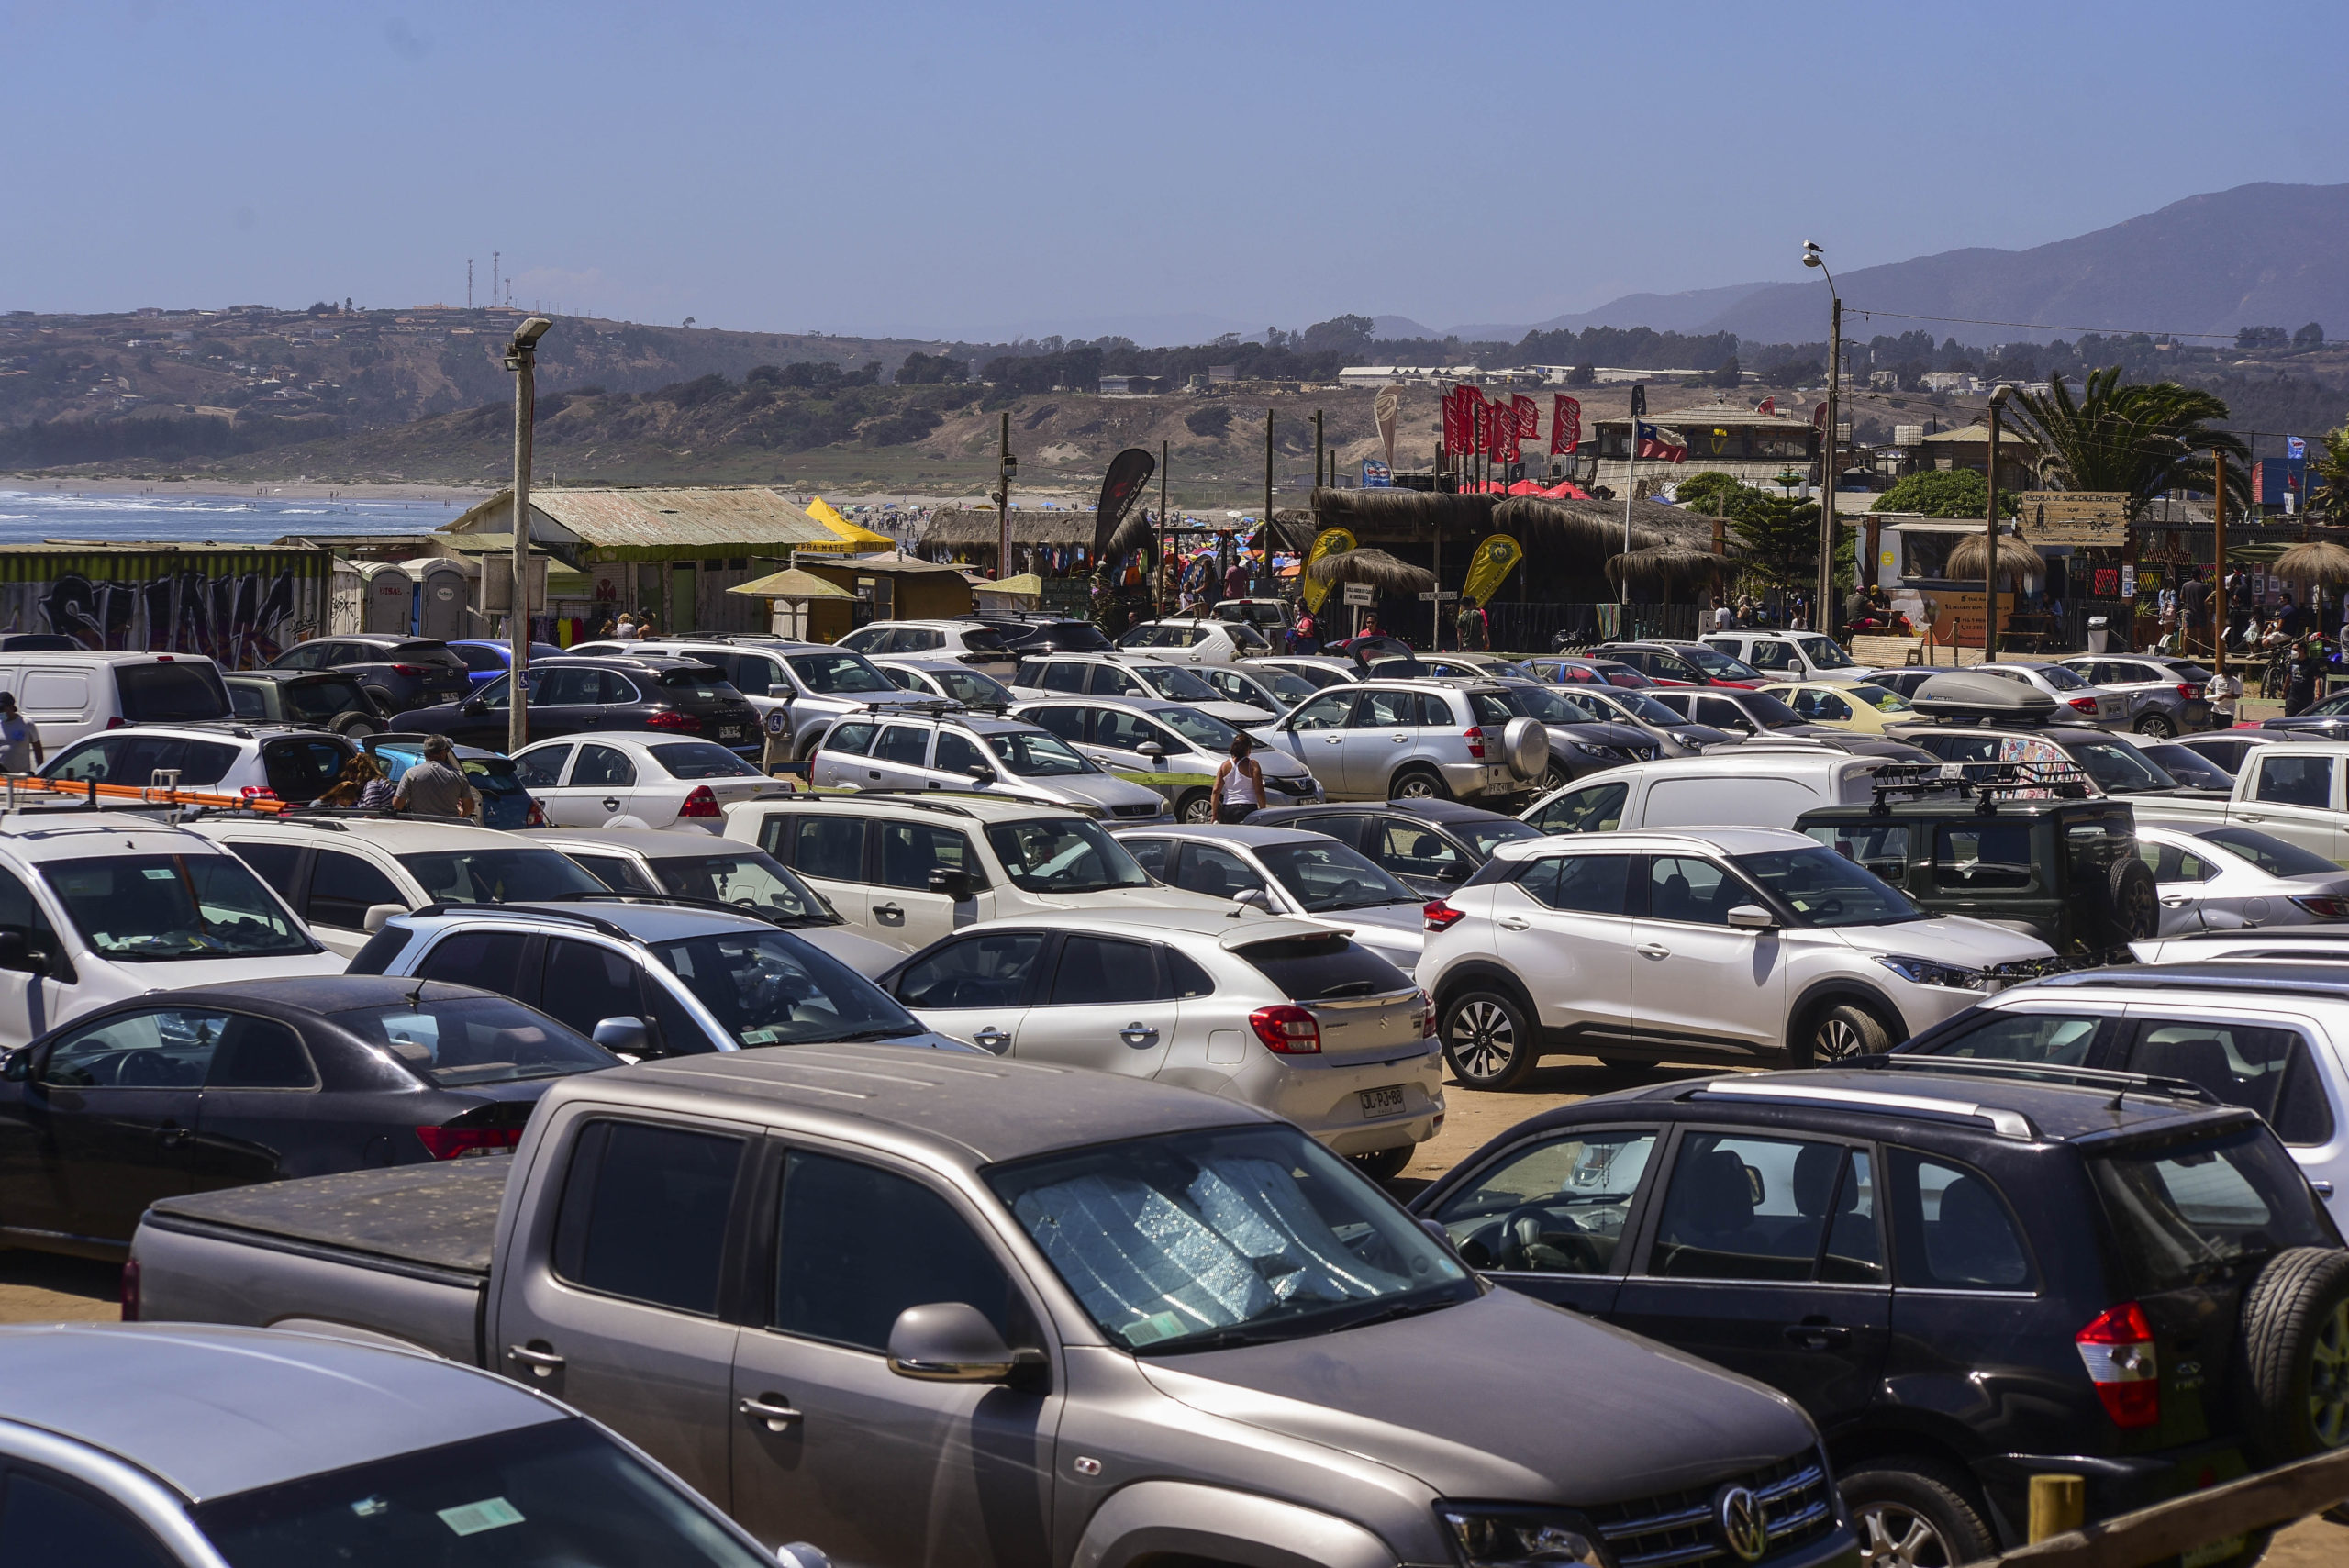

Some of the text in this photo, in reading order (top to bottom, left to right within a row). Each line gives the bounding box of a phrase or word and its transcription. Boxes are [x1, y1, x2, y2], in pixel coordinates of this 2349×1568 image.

[1116, 471, 1150, 519] RIP CURL
[2063, 495, 2077, 503] SURF
[795, 542, 845, 552] ERBA MATE
